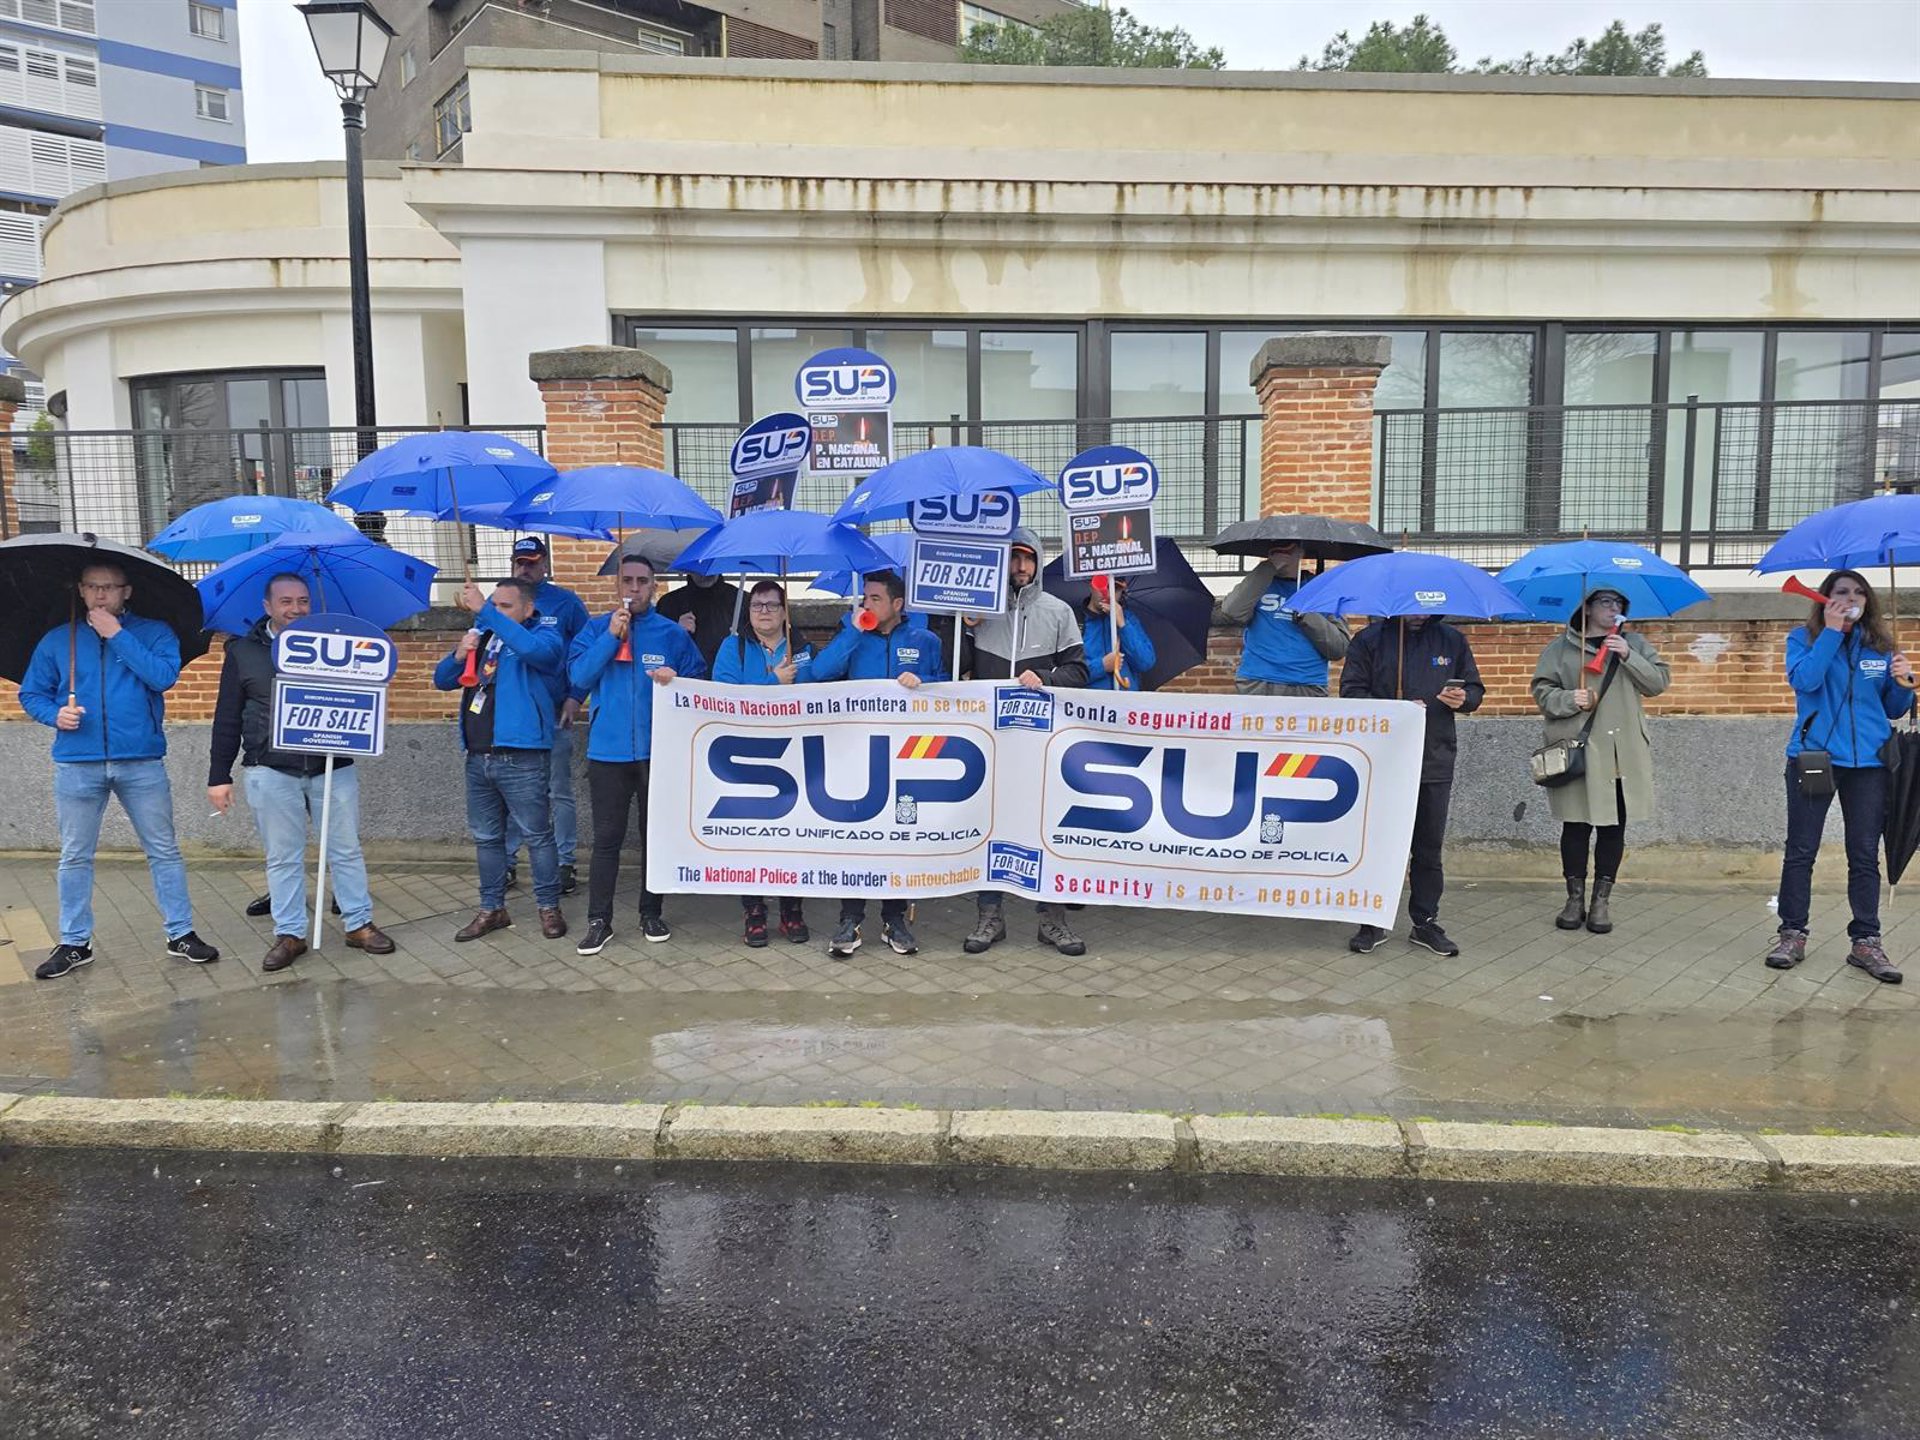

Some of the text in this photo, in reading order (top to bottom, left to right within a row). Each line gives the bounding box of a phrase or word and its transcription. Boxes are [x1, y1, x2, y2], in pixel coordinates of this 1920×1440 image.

[806, 369, 886, 397] SUP
[812, 415, 837, 425] SUP
[740, 431, 806, 464] SUP
[816, 444, 826, 455] P.
[816, 457, 831, 468] EN
[1069, 467, 1149, 498] SUP
[919, 493, 1009, 522] SUP
[1075, 517, 1098, 527] SUP
[1079, 541, 1143, 558] P. NACIONAL
[920, 562, 995, 588] FOR SALE
[1080, 559, 1094, 570] EN
[285, 635, 386, 668] SUP
[675, 692, 690, 708] La
[741, 700, 801, 716] Nacional
[807, 701, 823, 714] en
[828, 698, 841, 713] la
[846, 697, 907, 713] frontera
[912, 699, 928, 712] no
[934, 699, 950, 712] se
[956, 698, 986, 713] toca
[1000, 700, 1050, 717] FOR SALE
[286, 706, 371, 731] FOR SALE
[1128, 711, 1231, 731] seguridad
[1242, 714, 1265, 731] no
[1275, 715, 1297, 731] se
[1308, 714, 1390, 735] negocia
[707, 735, 986, 823] SUP
[1058, 740, 1359, 842] SUP
[702, 825, 981, 841] SINDICATO UNIFICADO DE POLICIA
[1052, 834, 1349, 863] SINDICATO UNIFICADO DE POLICIA
[677, 866, 981, 888] The National Police at the border is untouchable
[993, 855, 1037, 876] FOR SALE
[1055, 874, 1153, 900] Security
[1166, 881, 1186, 899] is
[1258, 887, 1383, 909] negotiable
